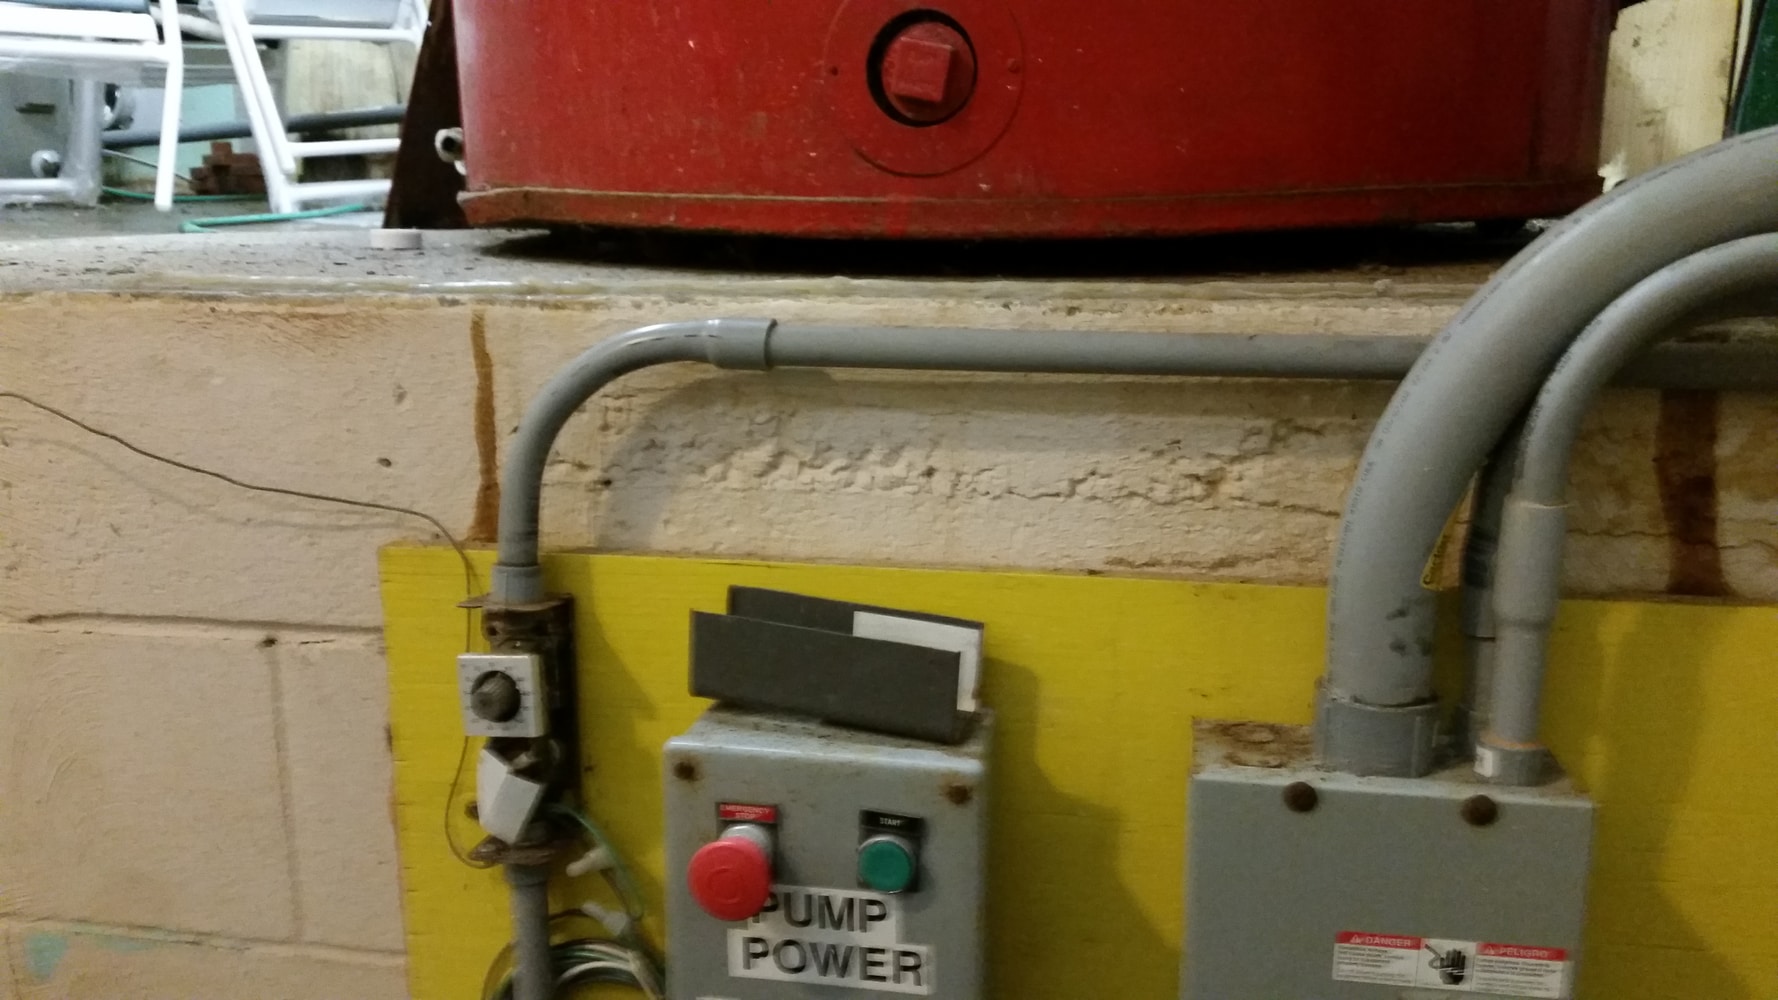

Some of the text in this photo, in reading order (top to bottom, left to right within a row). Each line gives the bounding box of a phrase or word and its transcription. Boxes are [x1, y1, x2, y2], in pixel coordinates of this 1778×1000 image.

[719, 803, 769, 814] EMERGENCY
[879, 816, 902, 827] START
[751, 893, 887, 933] PUMP
[1364, 935, 1411, 947] DANGER
[1499, 947, 1549, 958] PELIGRO
[742, 936, 923, 986] POWER
